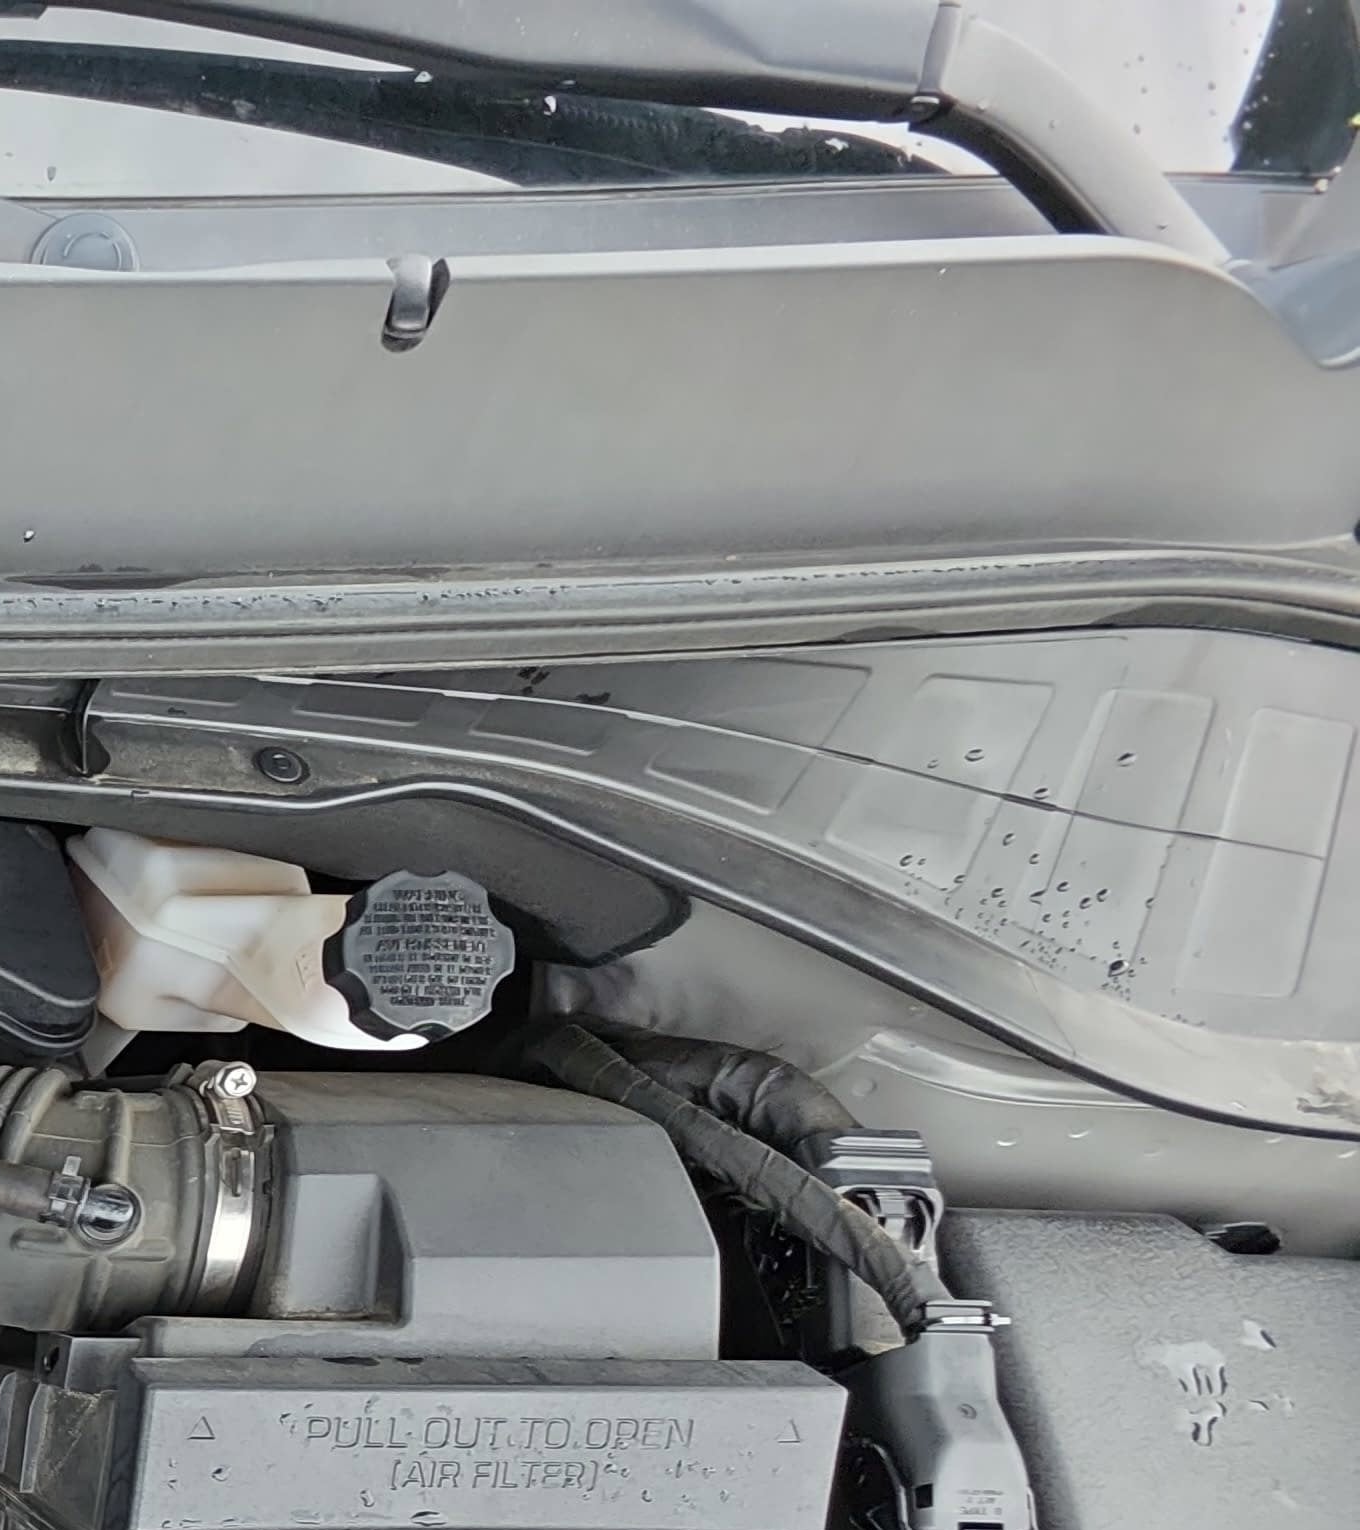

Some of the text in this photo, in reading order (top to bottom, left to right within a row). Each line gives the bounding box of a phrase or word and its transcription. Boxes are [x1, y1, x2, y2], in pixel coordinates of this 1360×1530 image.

[305, 1416, 697, 1450] PULL OUT TO OPEN
